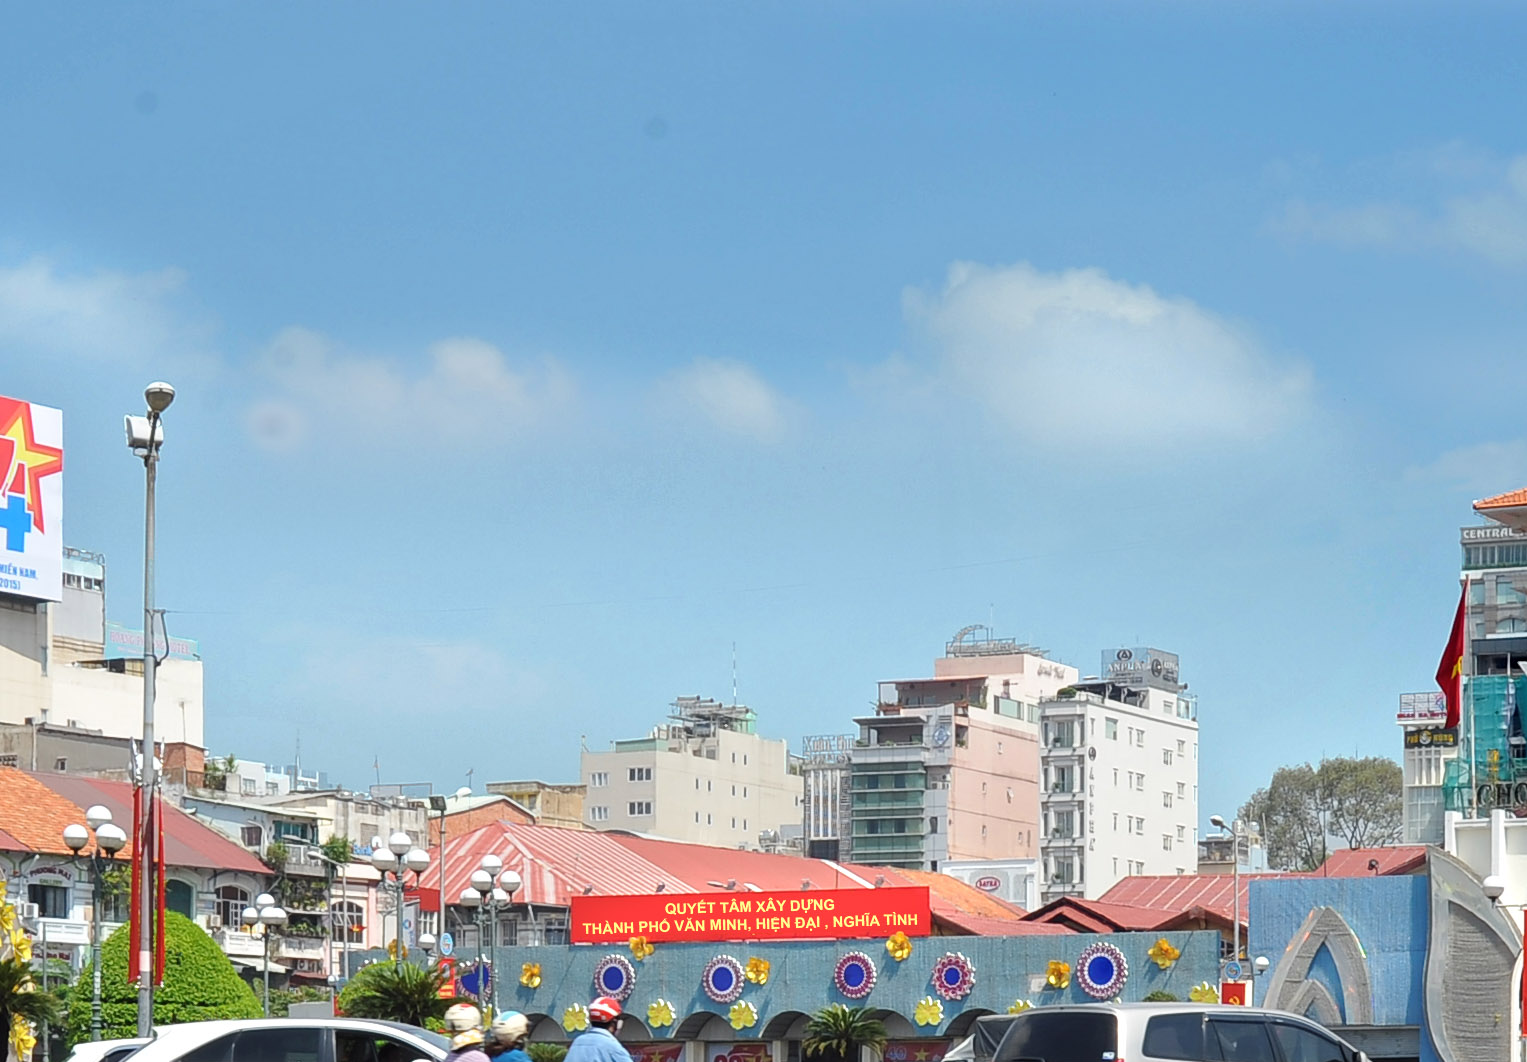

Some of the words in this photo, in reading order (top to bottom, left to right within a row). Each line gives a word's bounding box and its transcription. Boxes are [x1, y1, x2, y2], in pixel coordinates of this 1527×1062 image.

[1463, 528, 1514, 539] CENTRAL
[665, 899, 715, 915] QUYẾT
[720, 898, 752, 914] TÂM
[756, 897, 786, 913] XÂY
[790, 898, 835, 914] DỰNG
[582, 920, 634, 935] THÀNH
[638, 917, 671, 933] PHỐ
[674, 917, 705, 932] VĂN
[710, 918, 752, 932] MINH,
[756, 916, 791, 933] HIỆN
[794, 917, 821, 931] ĐẠI
[833, 912, 880, 928] NGHĨA
[884, 911, 919, 926] TÌNH
